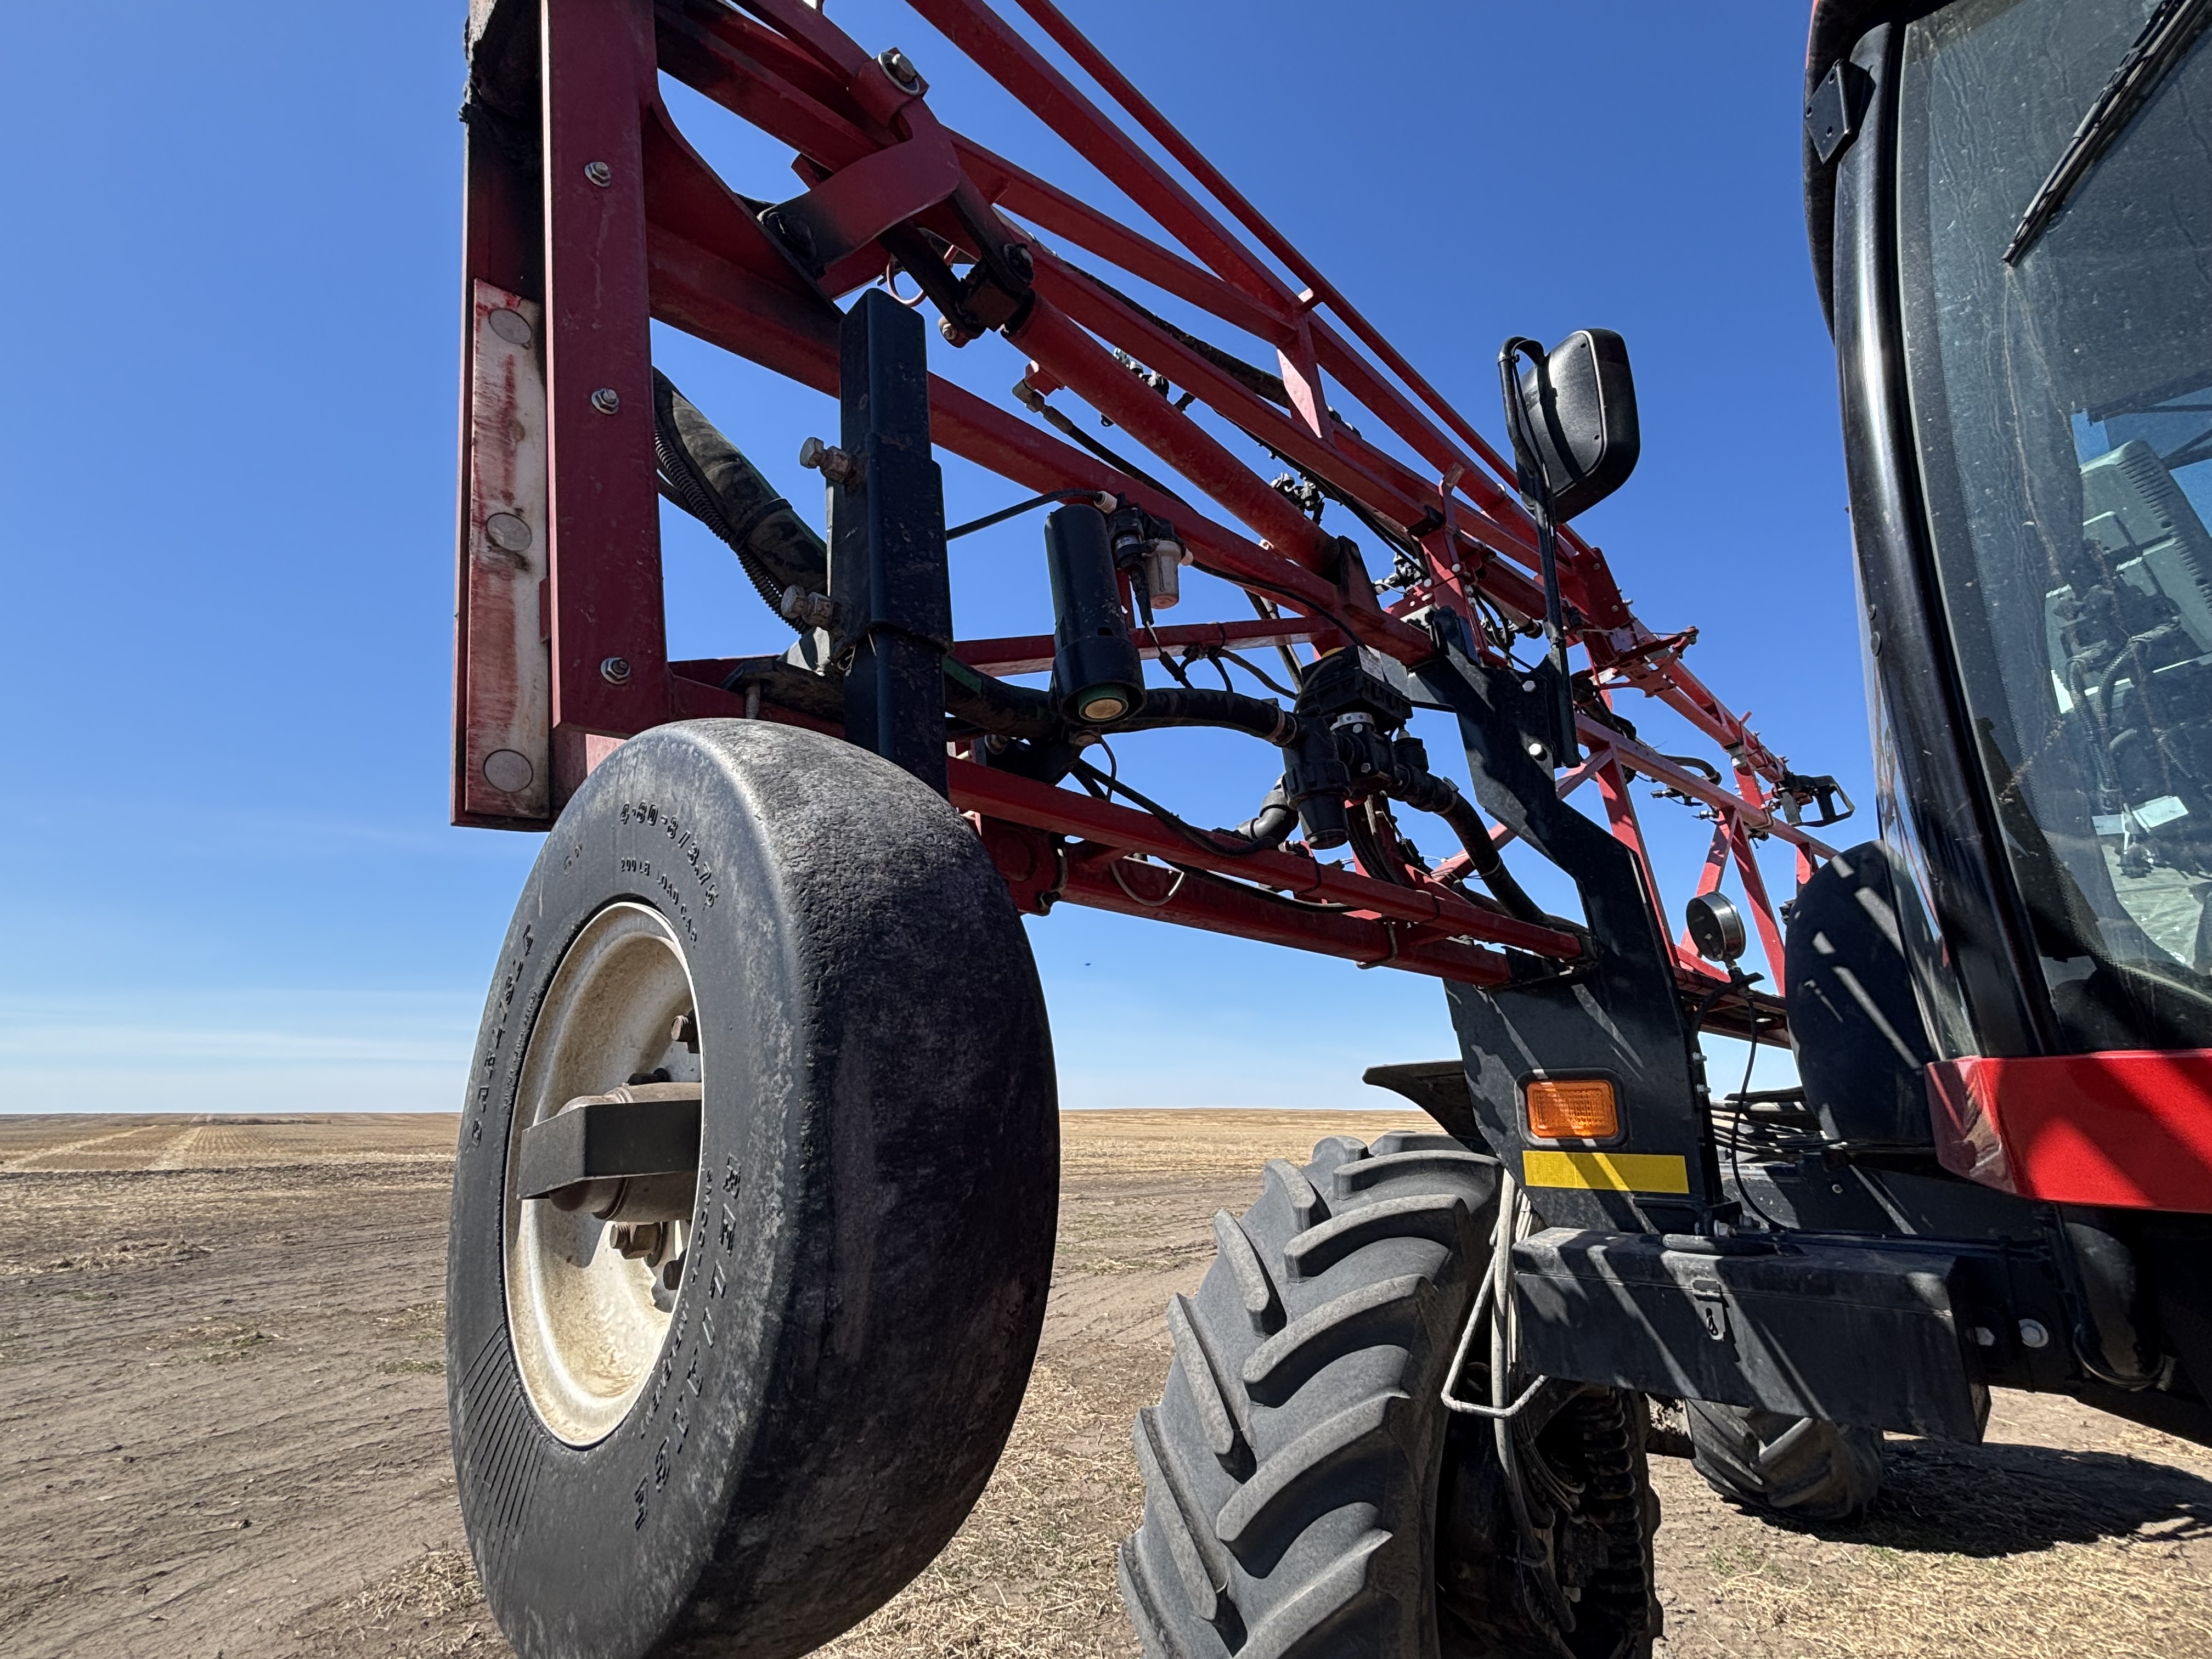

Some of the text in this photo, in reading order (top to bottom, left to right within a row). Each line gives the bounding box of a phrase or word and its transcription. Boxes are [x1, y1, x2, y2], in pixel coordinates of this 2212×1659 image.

[621, 856, 636, 872] 200
[656, 872, 679, 905] LOAD
[472, 921, 534, 1147] CARLISLE
[690, 1169, 712, 1285] SMOOTH
[634, 1152, 741, 1531] RELIANCE
